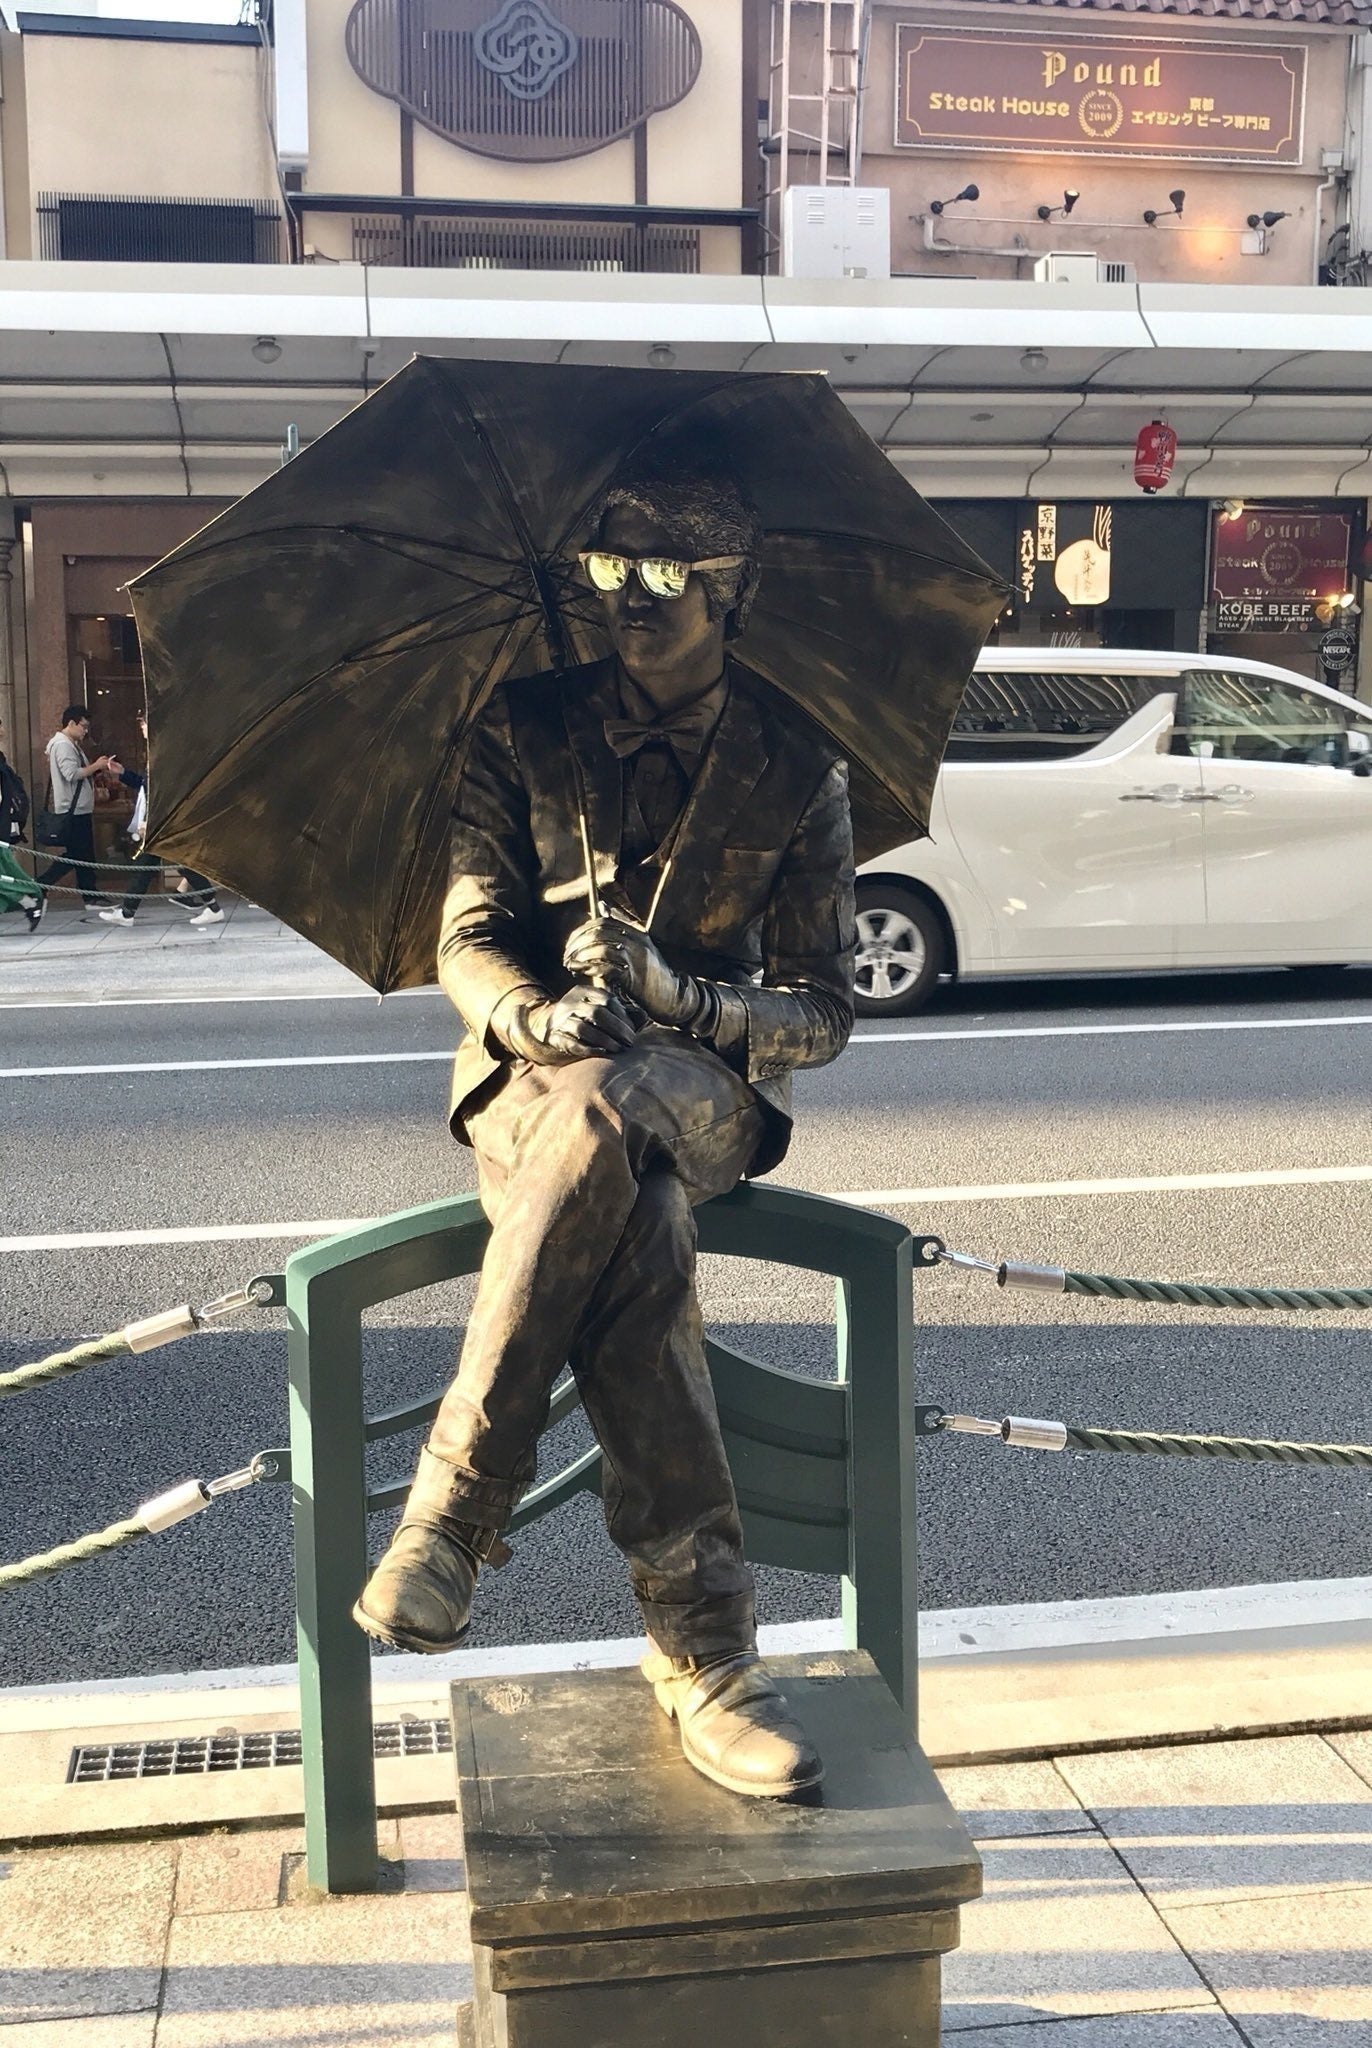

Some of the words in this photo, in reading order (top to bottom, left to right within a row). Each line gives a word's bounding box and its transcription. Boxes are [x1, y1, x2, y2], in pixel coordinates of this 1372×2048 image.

[1041, 51, 1162, 88] Pound
[929, 92, 996, 113] Steak
[1002, 96, 1070, 117] House
[1088, 103, 1112, 111] SINCE
[1189, 97, 1215, 112] 京都
[1088, 111, 1113, 122] 2009
[1039, 507, 1055, 559] 京野菜
[1246, 519, 1321, 542] Pound
[1217, 556, 1259, 568] Steak
[1219, 603, 1264, 616] KOBE
[1268, 604, 1311, 616] BEEF
